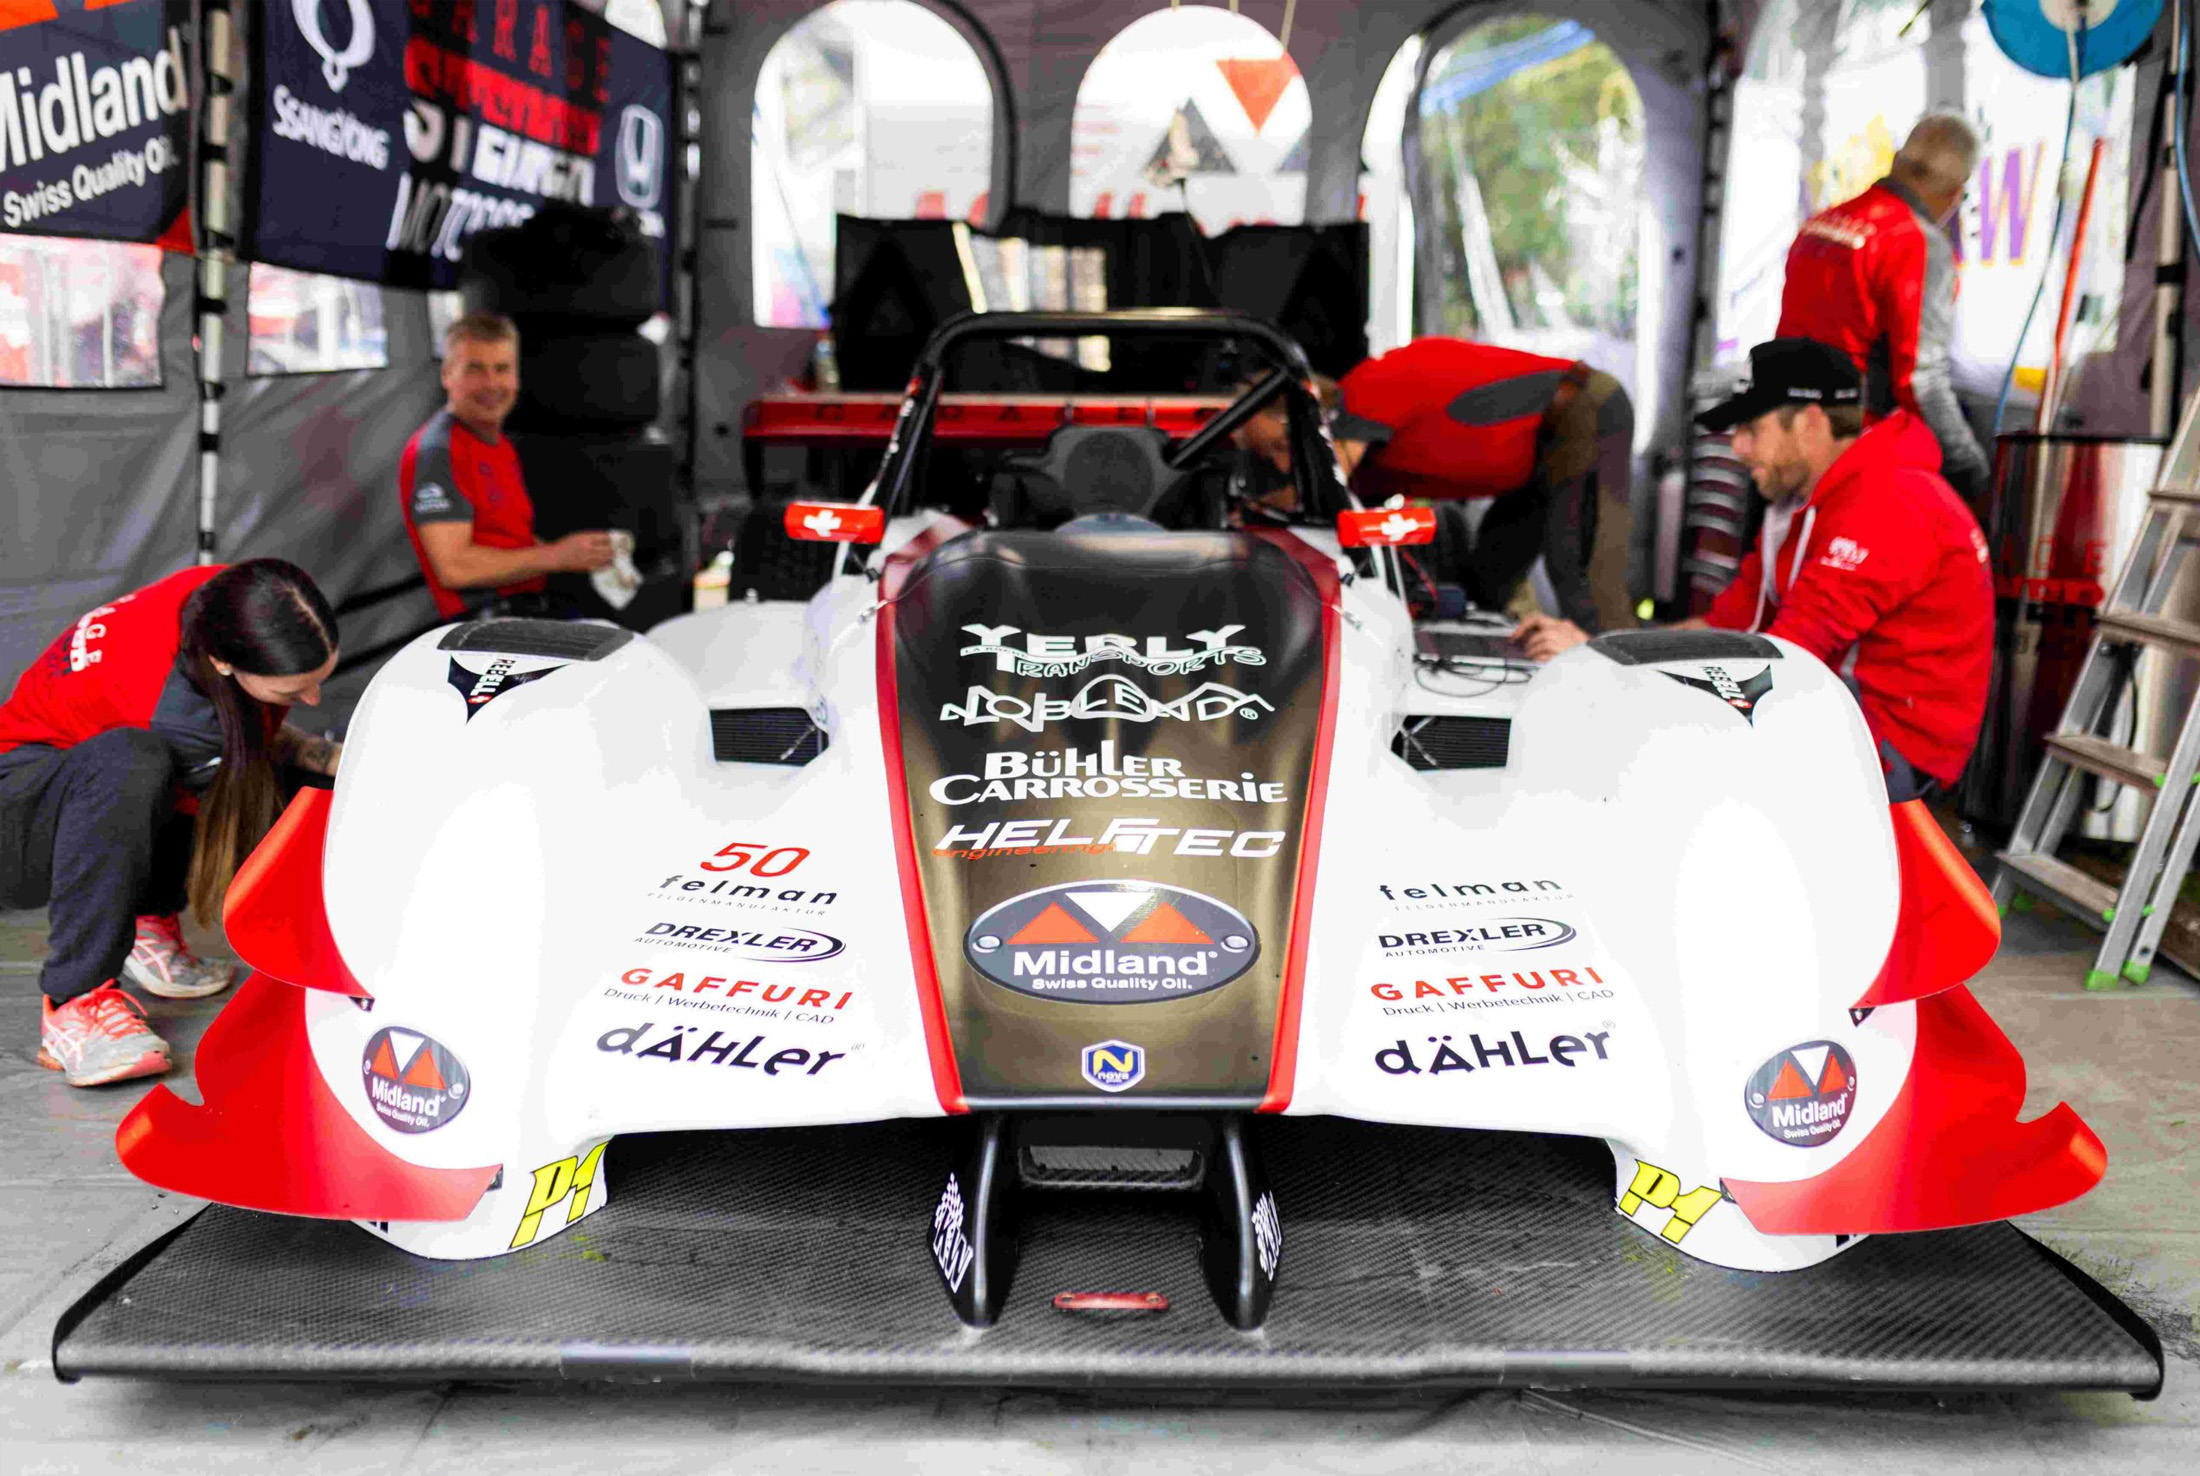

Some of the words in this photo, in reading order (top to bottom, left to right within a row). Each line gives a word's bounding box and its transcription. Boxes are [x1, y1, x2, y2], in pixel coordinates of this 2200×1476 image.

[3, 180, 73, 228] Swiss
[72, 149, 146, 201] Quality
[961, 624, 1246, 672] YERLY
[700, 842, 810, 877] 50
[659, 874, 838, 905] felman
[1379, 879, 1563, 901] felman
[633, 937, 734, 954] AUTOMOTIVE
[645, 922, 819, 952] DREXLER
[1378, 923, 1547, 949] DREXLER
[1385, 944, 1485, 958] AUTOMOTIVE
[1013, 950, 1208, 976] Midland
[621, 968, 853, 1010] GAFFURI
[1032, 978, 1088, 990] Swiss
[1091, 977, 1158, 991] Quality
[1370, 966, 1604, 1001] GAFFURI
[603, 988, 652, 1004] Druck
[668, 997, 780, 1019] Werbetechnik
[795, 1012, 835, 1025] CAD
[1383, 1003, 1433, 1016] Druck
[1450, 994, 1563, 1012] Werbetechnik
[1577, 988, 1615, 1000] CAD
[372, 1076, 441, 1117] Midland
[1772, 1093, 1846, 1127] Midland
[1783, 1128, 1810, 1139] Swiss
[507, 1141, 609, 1250] P1
[1618, 1158, 1723, 1244] P1
